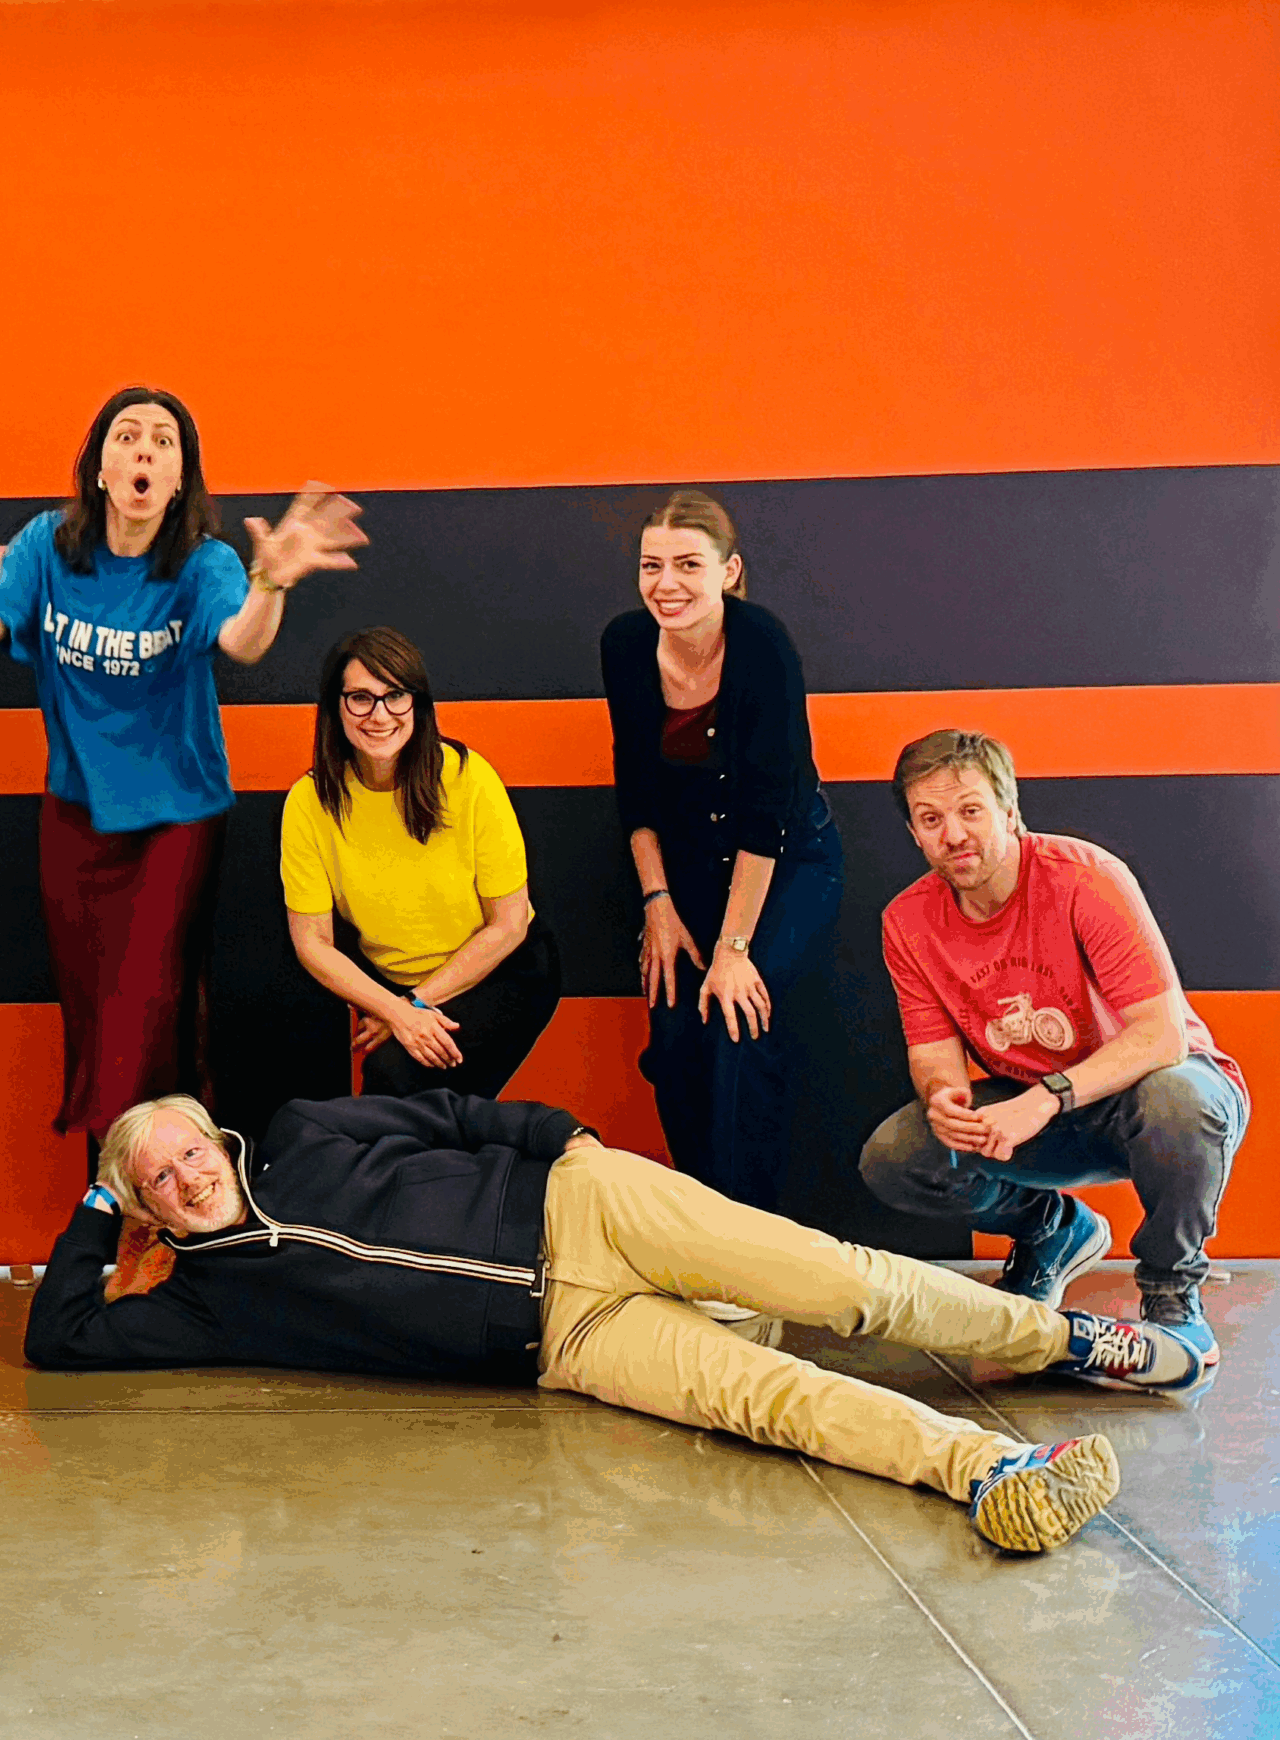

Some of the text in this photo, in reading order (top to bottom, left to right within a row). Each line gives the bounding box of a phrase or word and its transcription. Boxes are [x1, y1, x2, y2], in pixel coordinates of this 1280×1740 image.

[67, 618, 94, 653] IN
[95, 626, 137, 660] THE
[102, 659, 140, 676] 1972
